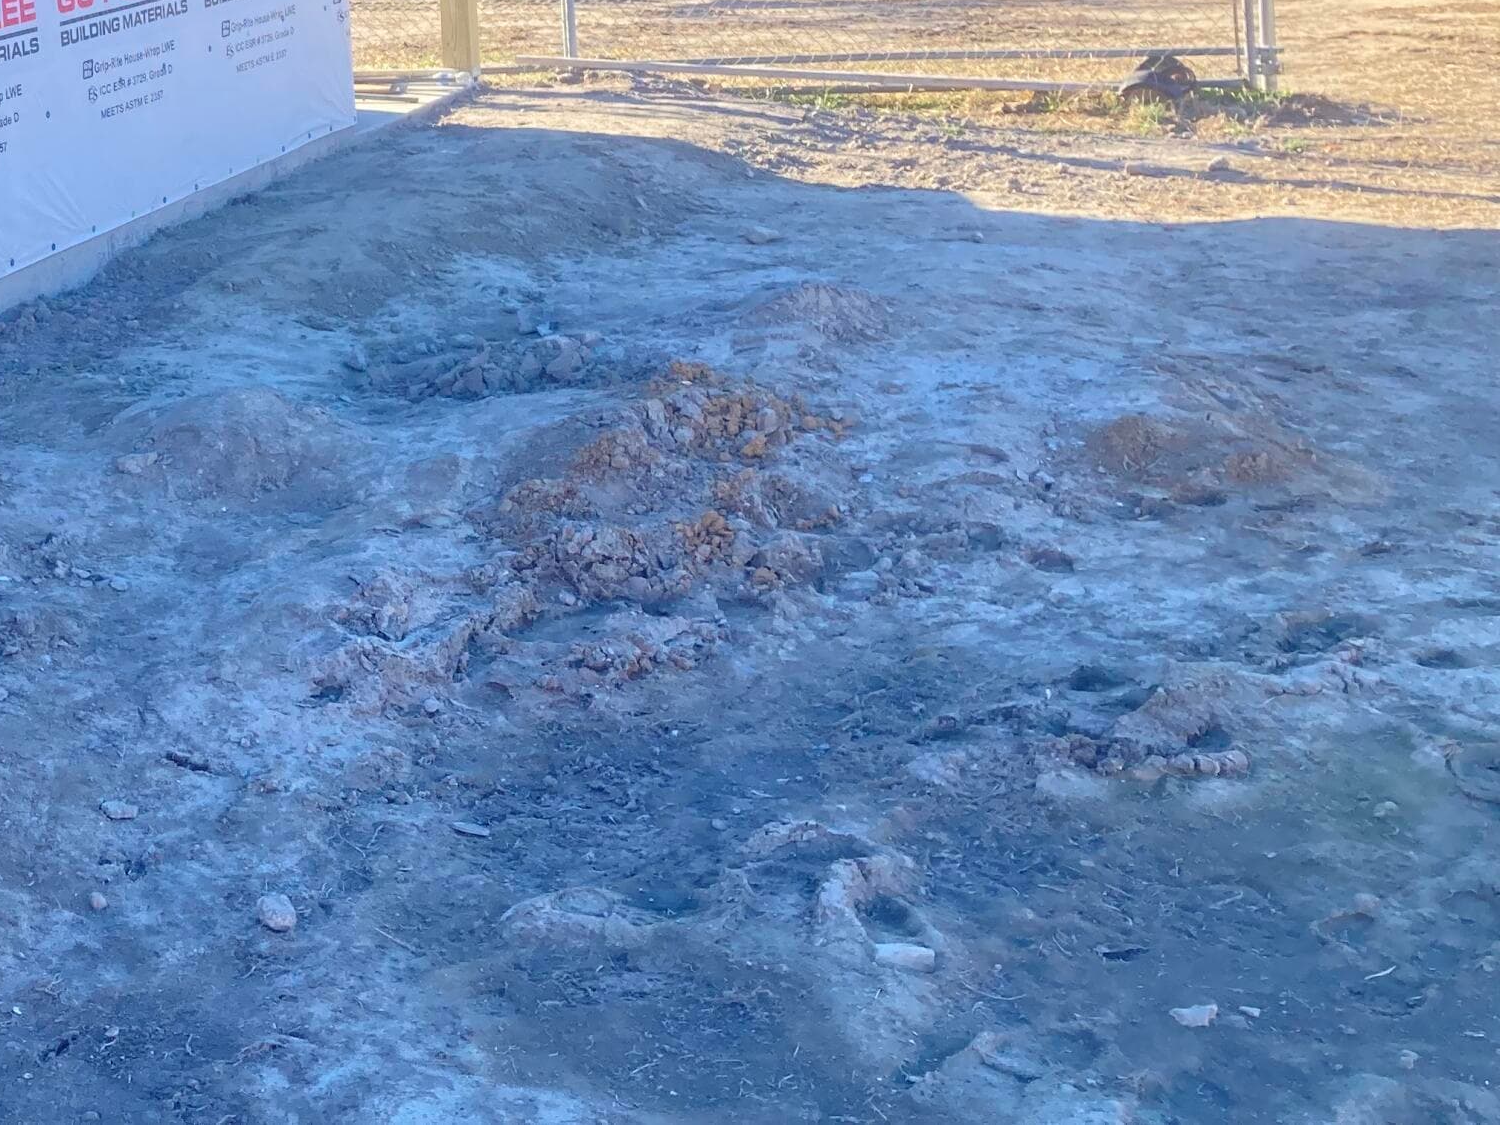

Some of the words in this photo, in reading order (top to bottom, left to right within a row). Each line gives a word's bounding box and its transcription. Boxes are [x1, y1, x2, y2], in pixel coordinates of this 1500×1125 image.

[60, 19, 120, 47] BUILDING
[122, 0, 188, 30] MATERIALS
[5, 84, 22, 99] LWE
[14, 112, 20, 123] D
[101, 104, 124, 118] MEETS
